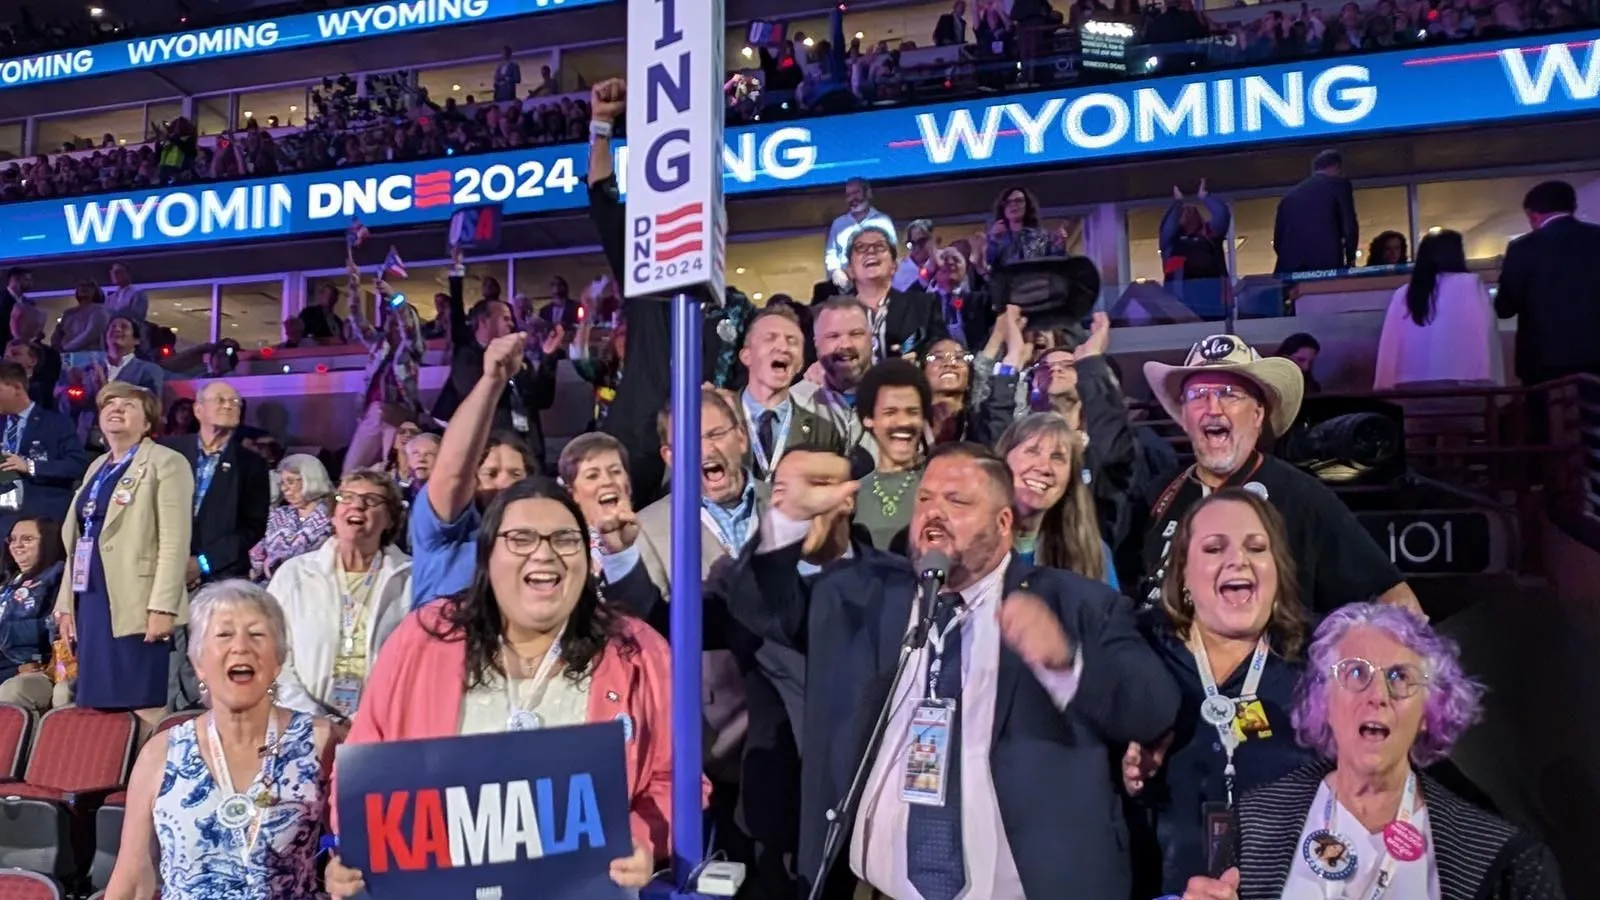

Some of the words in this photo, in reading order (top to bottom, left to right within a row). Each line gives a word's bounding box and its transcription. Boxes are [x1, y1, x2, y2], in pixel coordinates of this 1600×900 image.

[317, 0, 489, 38] WYOMING
[127, 22, 279, 65] WYOMING
[0, 49, 94, 84] OMING
[915, 64, 1377, 164] WYOMING
[308, 174, 412, 219] DNC
[453, 157, 579, 204] 2024
[633, 216, 651, 283] DNC
[655, 257, 703, 280] 2024
[1387, 521, 1453, 564] 101
[365, 772, 607, 874] KAMALA
